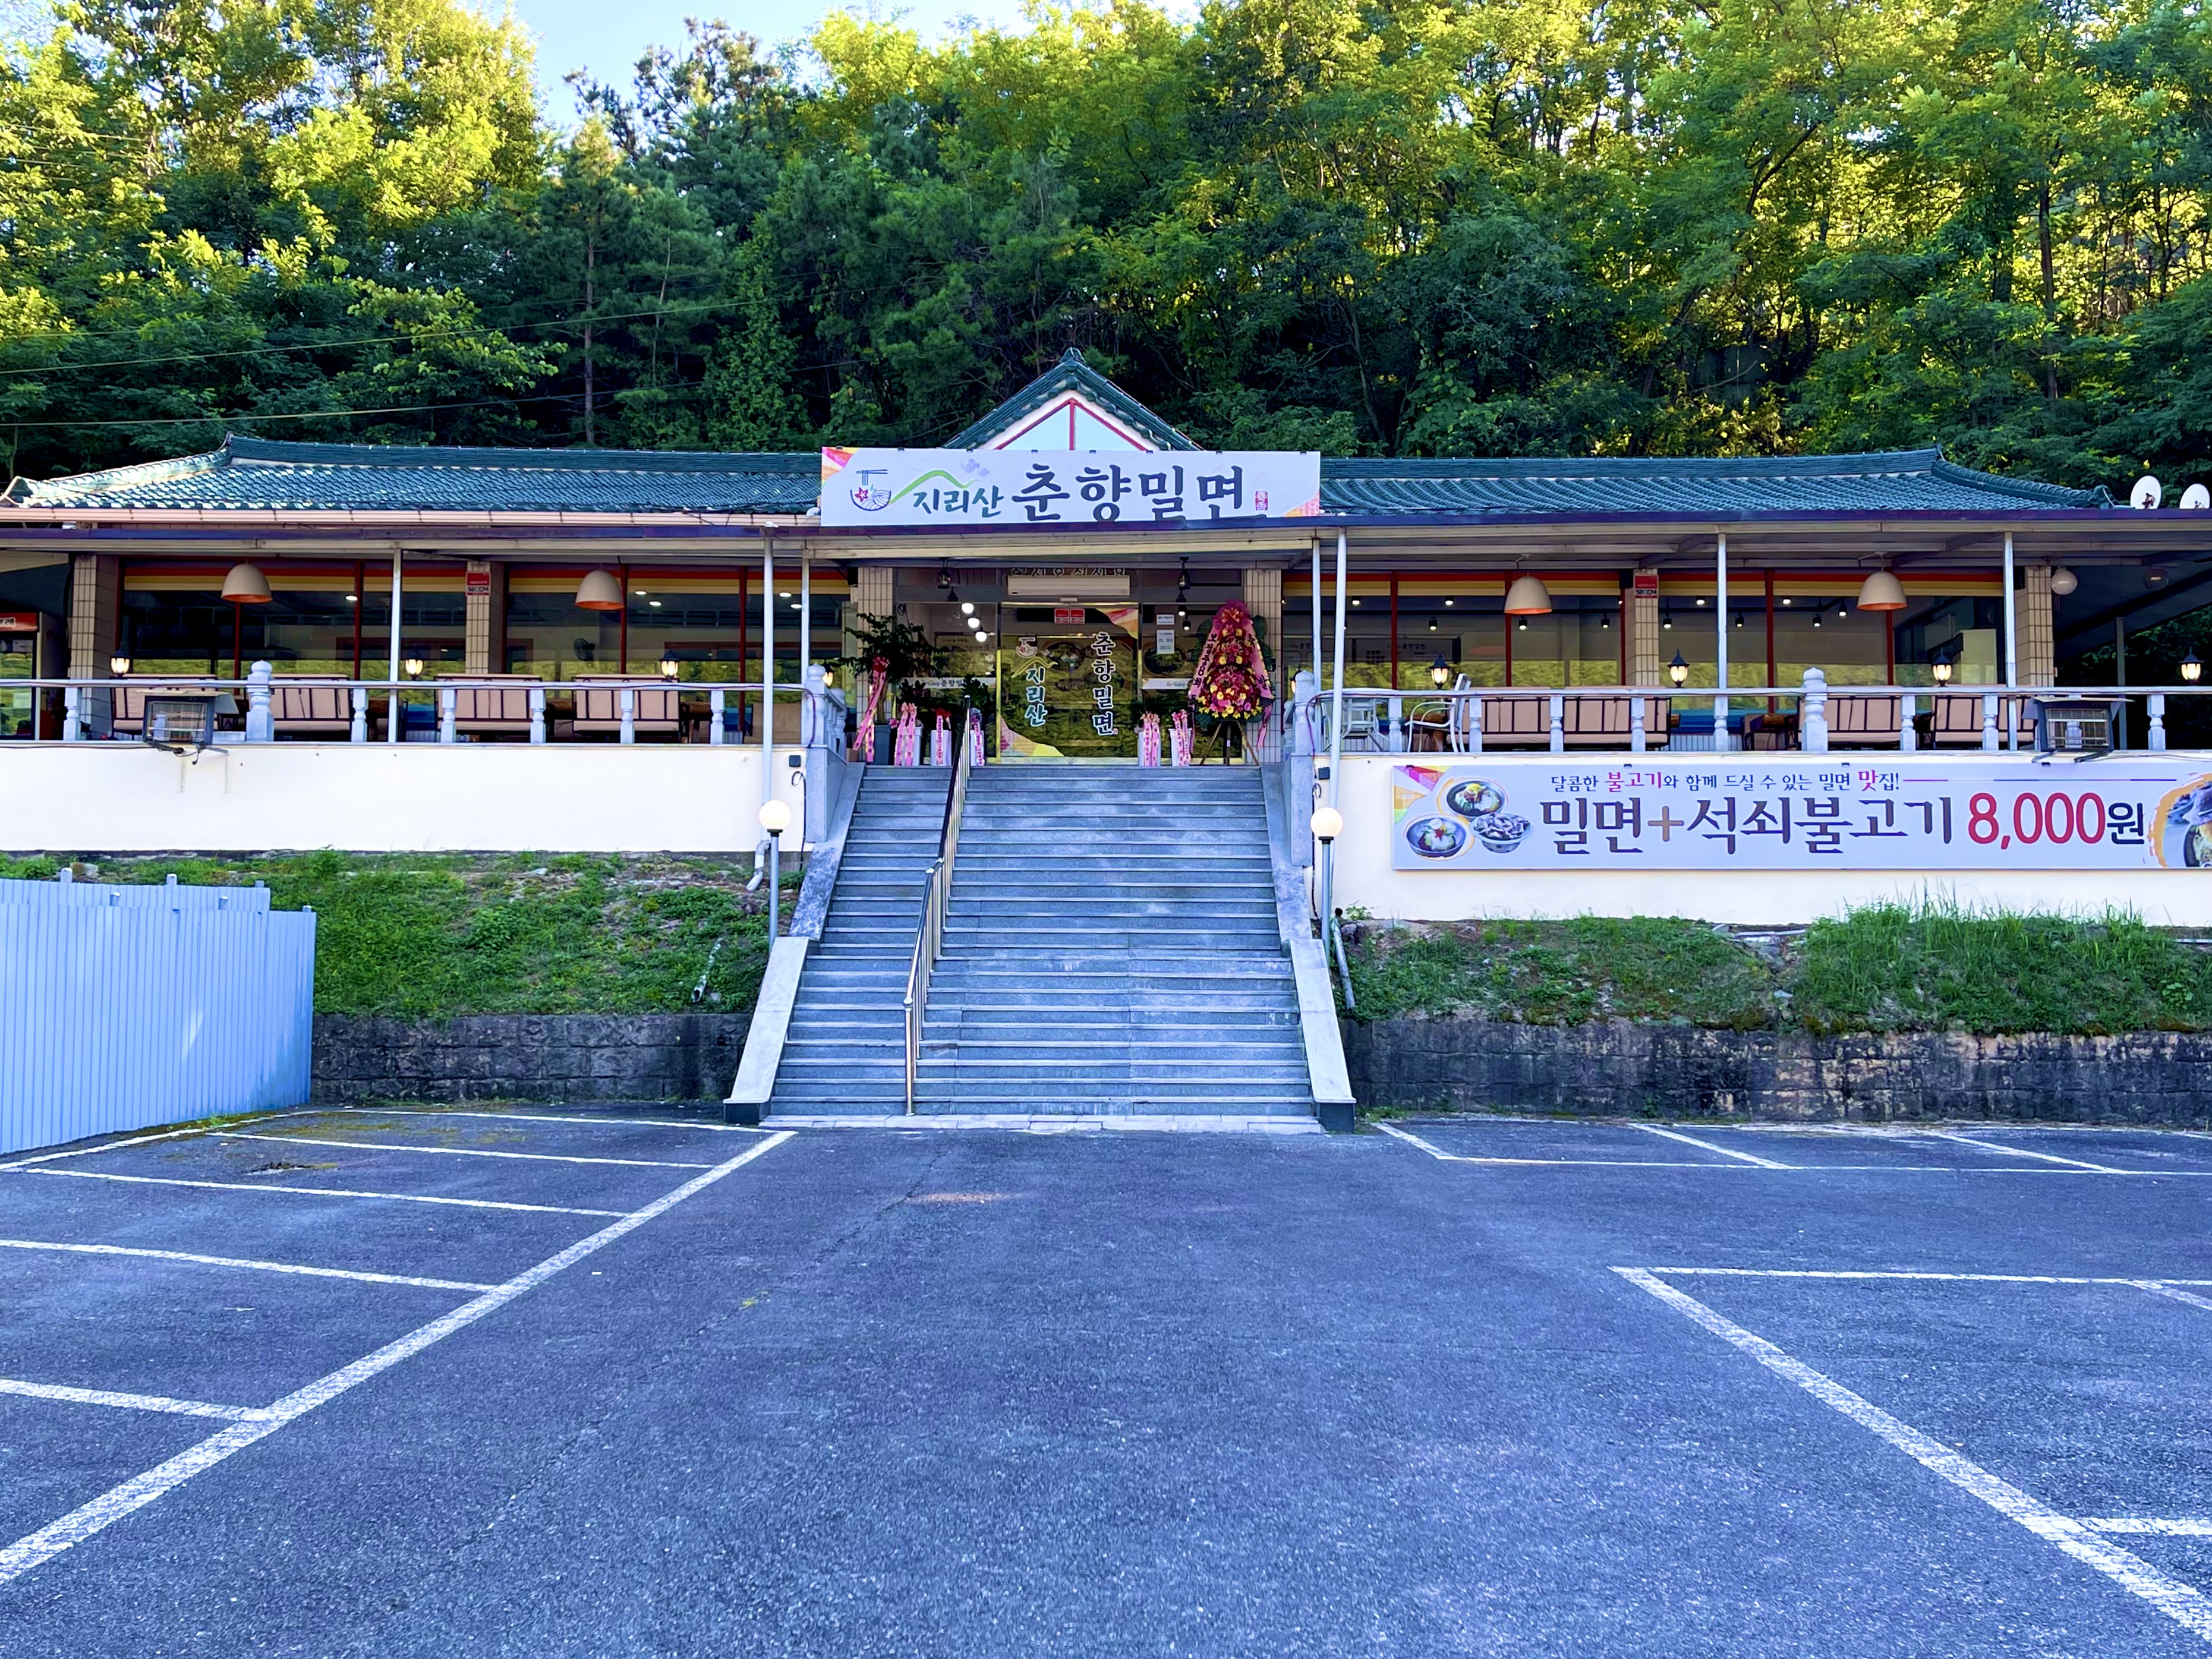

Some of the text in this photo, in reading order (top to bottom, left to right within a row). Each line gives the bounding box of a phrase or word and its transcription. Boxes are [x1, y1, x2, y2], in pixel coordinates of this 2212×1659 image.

[913, 463, 1243, 522] 지리산 춘향밀면
[1025, 666, 1048, 727] 지리산
[1092, 632, 1116, 736] 춘향밀면
[1551, 769, 1900, 792] 달콤한 불고기와 함께 드실 수 있는 밀면 맛집!
